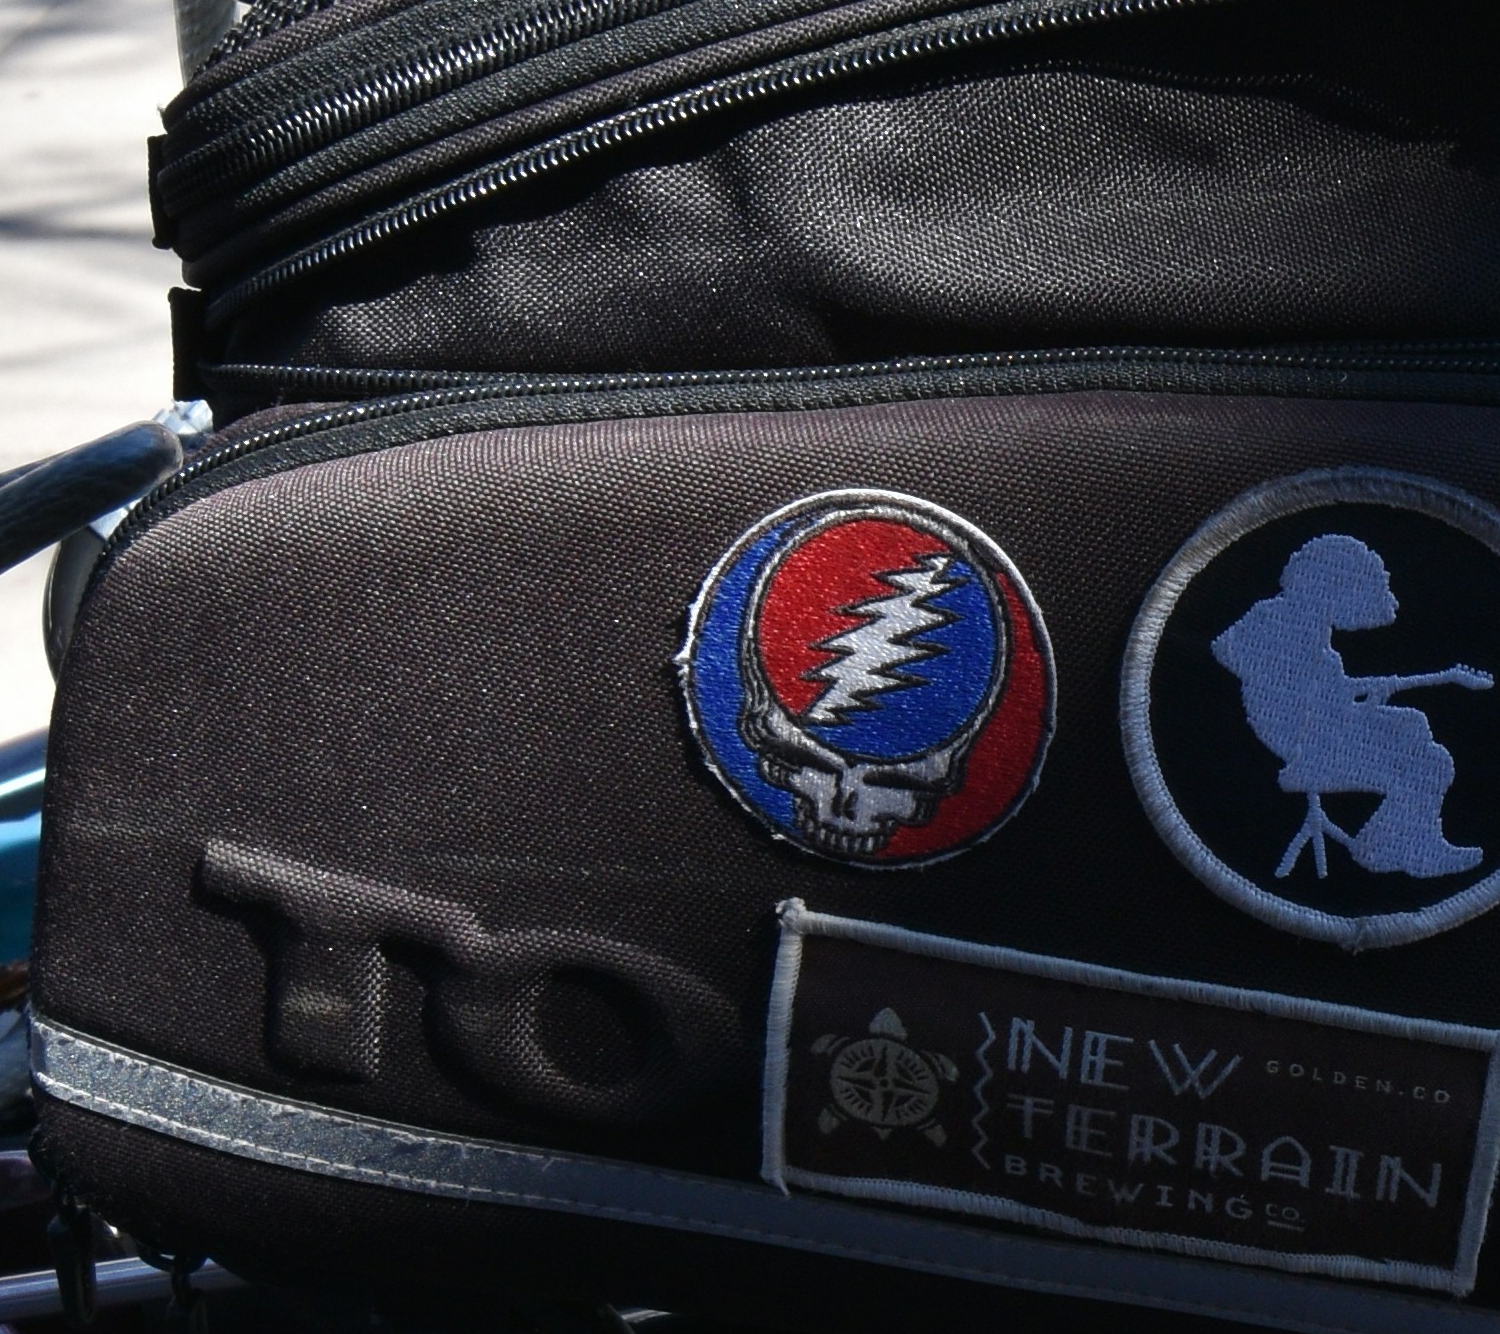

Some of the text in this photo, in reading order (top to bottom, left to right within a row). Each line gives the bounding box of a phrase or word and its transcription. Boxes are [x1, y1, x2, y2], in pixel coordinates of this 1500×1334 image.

[1006, 1016, 1243, 1099] NEW
[1003, 1154, 1253, 1220] BREWING
[1006, 1093, 1443, 1209] TERRAIN
